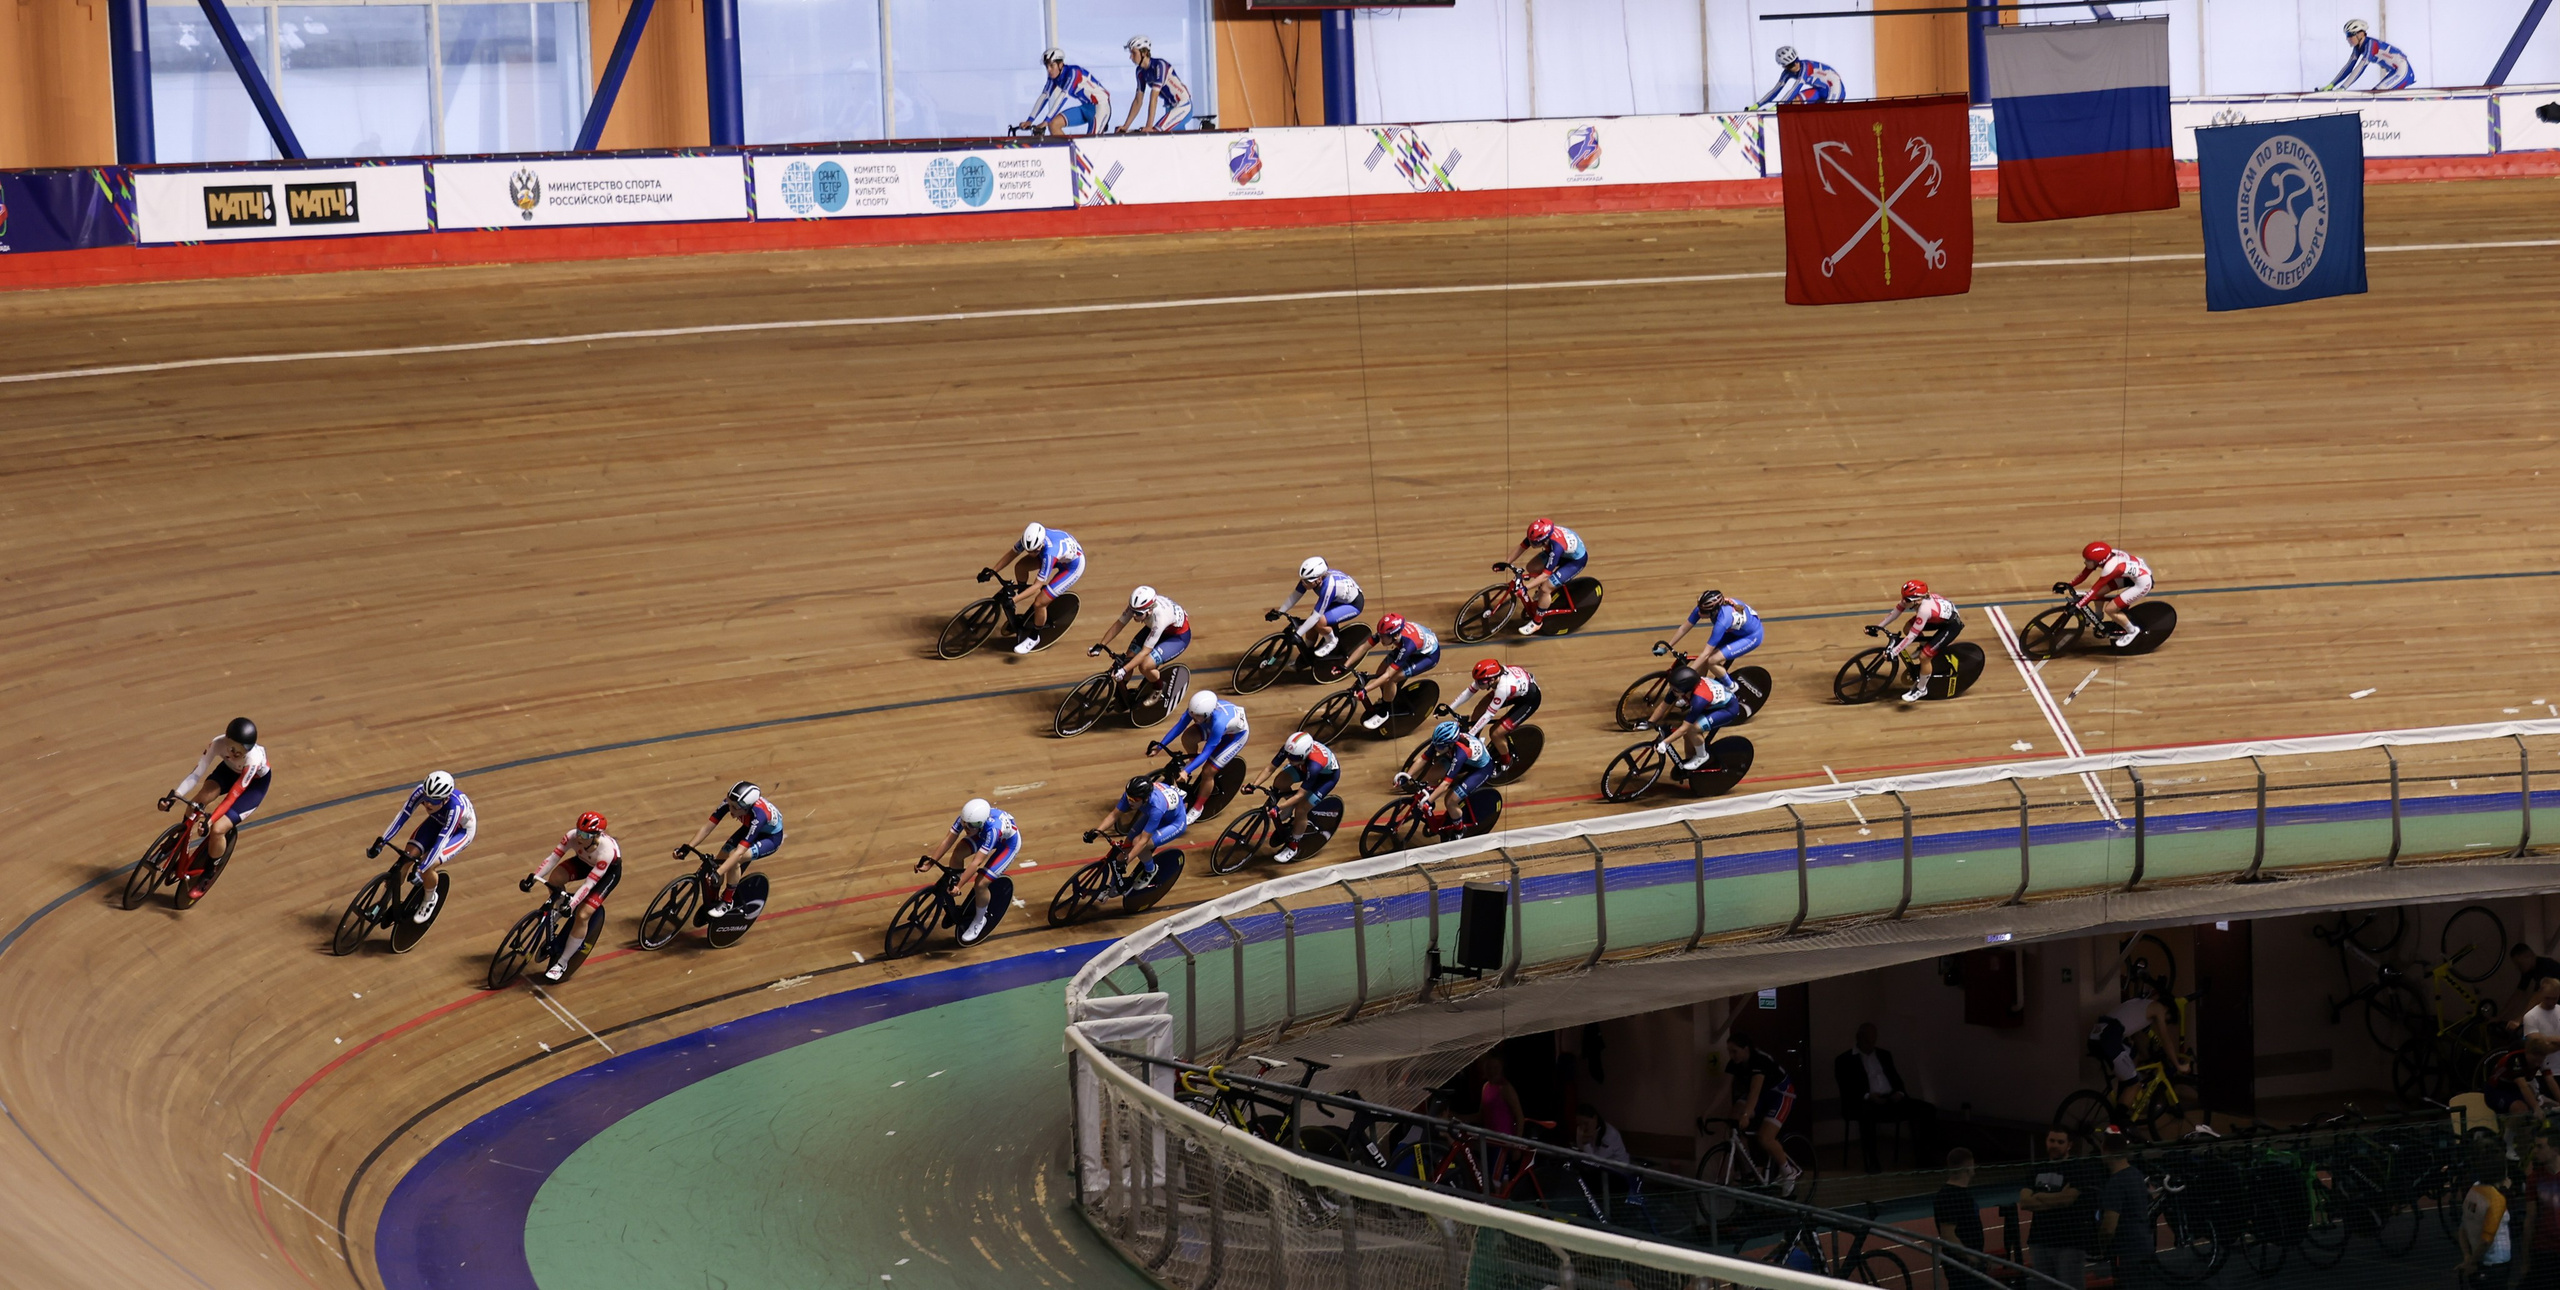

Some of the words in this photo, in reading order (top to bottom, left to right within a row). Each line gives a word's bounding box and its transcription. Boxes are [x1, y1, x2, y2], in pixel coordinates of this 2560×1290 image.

[2361, 119, 2389, 128] ОРТА
[2363, 131, 2401, 141] РАЦИИ
[854, 165, 884, 174] КОМИТЕТ
[886, 165, 897, 174] ПО
[998, 160, 1029, 169] КОМИТЕТ
[1031, 159, 1042, 168] ПО
[818, 170, 841, 181] САНКТ
[962, 165, 984, 176] САНКТ
[998, 168, 1045, 179] ФИЗИЧЕСКОЙ
[854, 174, 900, 185] ФИЗИЧЕСКОЙ
[962, 177, 986, 188] ПЕТЕР
[2241, 167, 2257, 223] ШВСМ
[2256, 146, 2272, 168] ПО
[2276, 140, 2326, 214] ВЕЛОСПОРТУ
[548, 180, 623, 192] МИНИСТЕРСТВО
[625, 179, 662, 190] СПОРТА
[819, 182, 842, 193] ПЕТЕР
[999, 181, 1032, 190] КУЛЬТУРЕ
[855, 187, 886, 196] КУЛЬТУРЕ
[963, 188, 982, 199] БУРГ
[1000, 193, 1006, 201] И
[1007, 191, 1034, 200] СПОРТУ
[290, 187, 354, 219] МАТЧ!
[549, 193, 613, 206] РОССИЙСКОЙ
[616, 193, 673, 205] ФЕДЕРАЦИИ
[820, 193, 838, 204] БУРГ
[863, 198, 889, 206] СПОРТУ
[208, 191, 272, 222] МАТЧ!
[2245, 227, 2324, 286] САНКТ-ПЕТЕРБУРГ
[1366, 1141, 1388, 1168] BM
